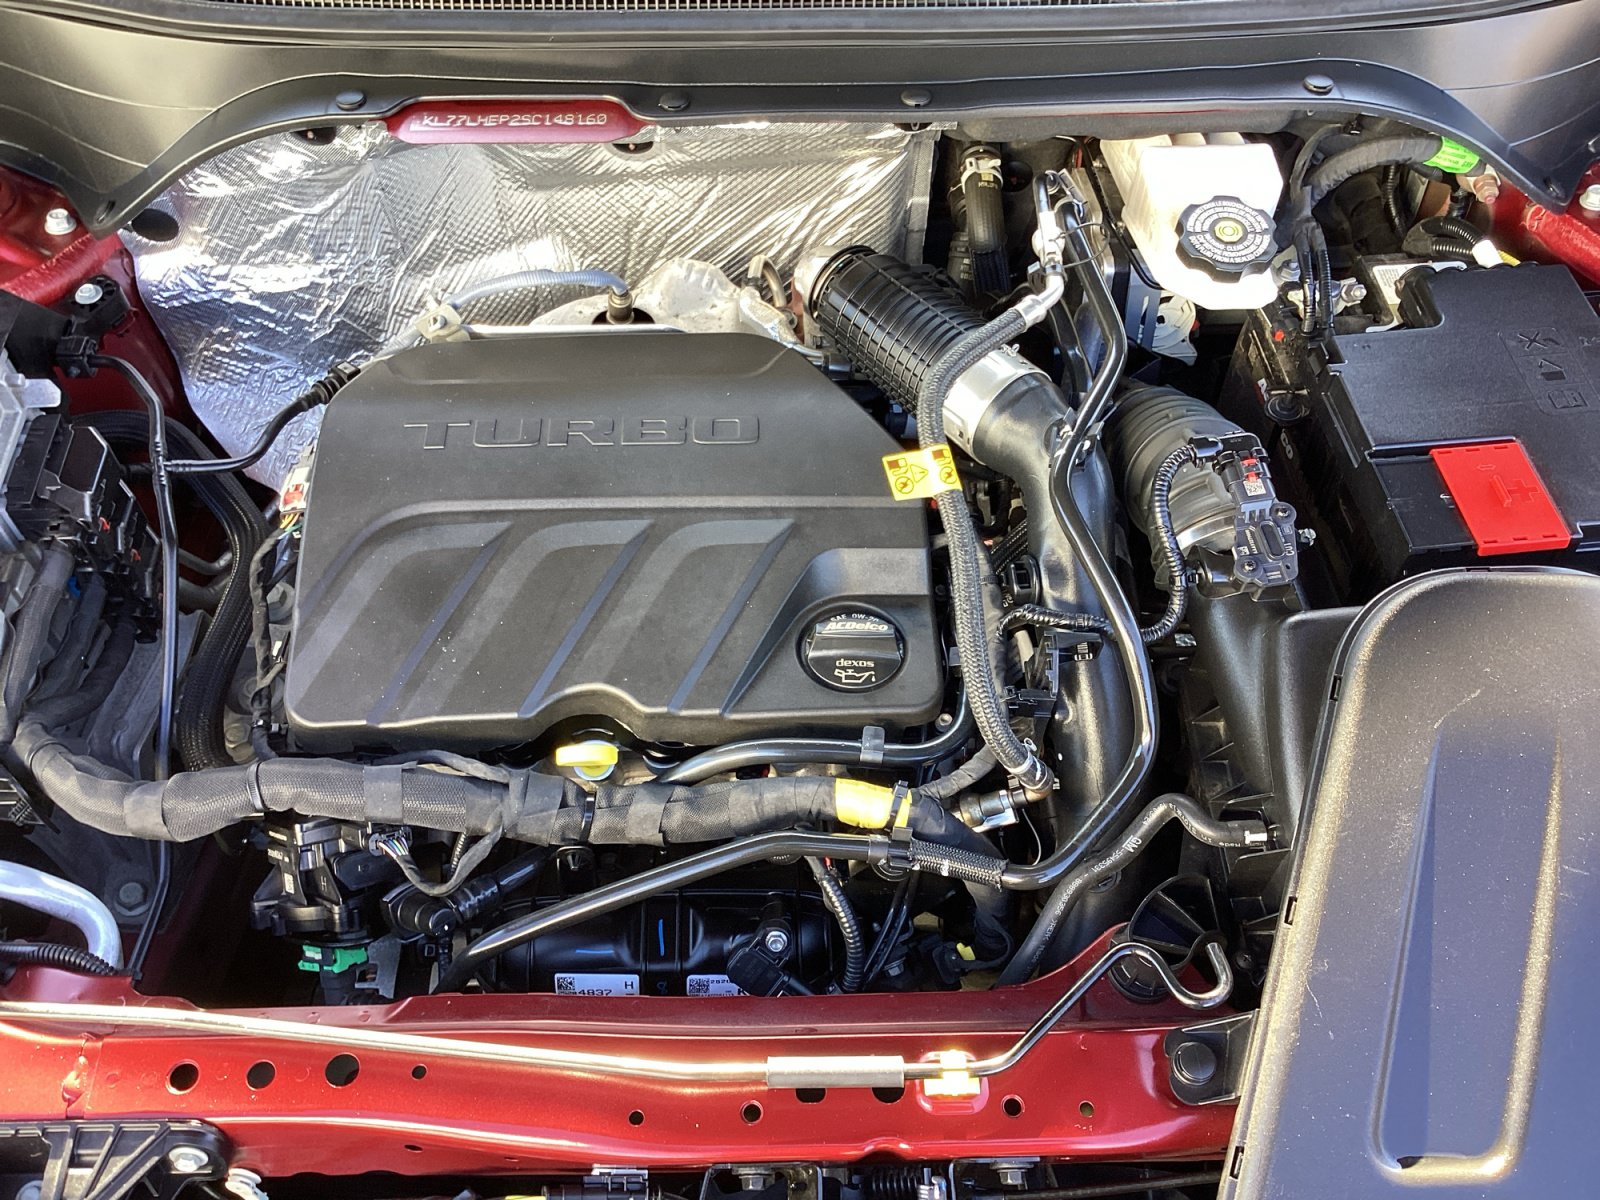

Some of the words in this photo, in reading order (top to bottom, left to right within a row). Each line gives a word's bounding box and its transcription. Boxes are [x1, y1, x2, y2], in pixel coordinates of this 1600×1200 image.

[422, 112, 607, 127] KL77LHEP2SC148160
[404, 417, 760, 449] TURBO
[824, 621, 889, 631] ACDelco
[836, 658, 875, 667] dexos
[1122, 835, 1143, 853] GM
[624, 981, 634, 989] H
